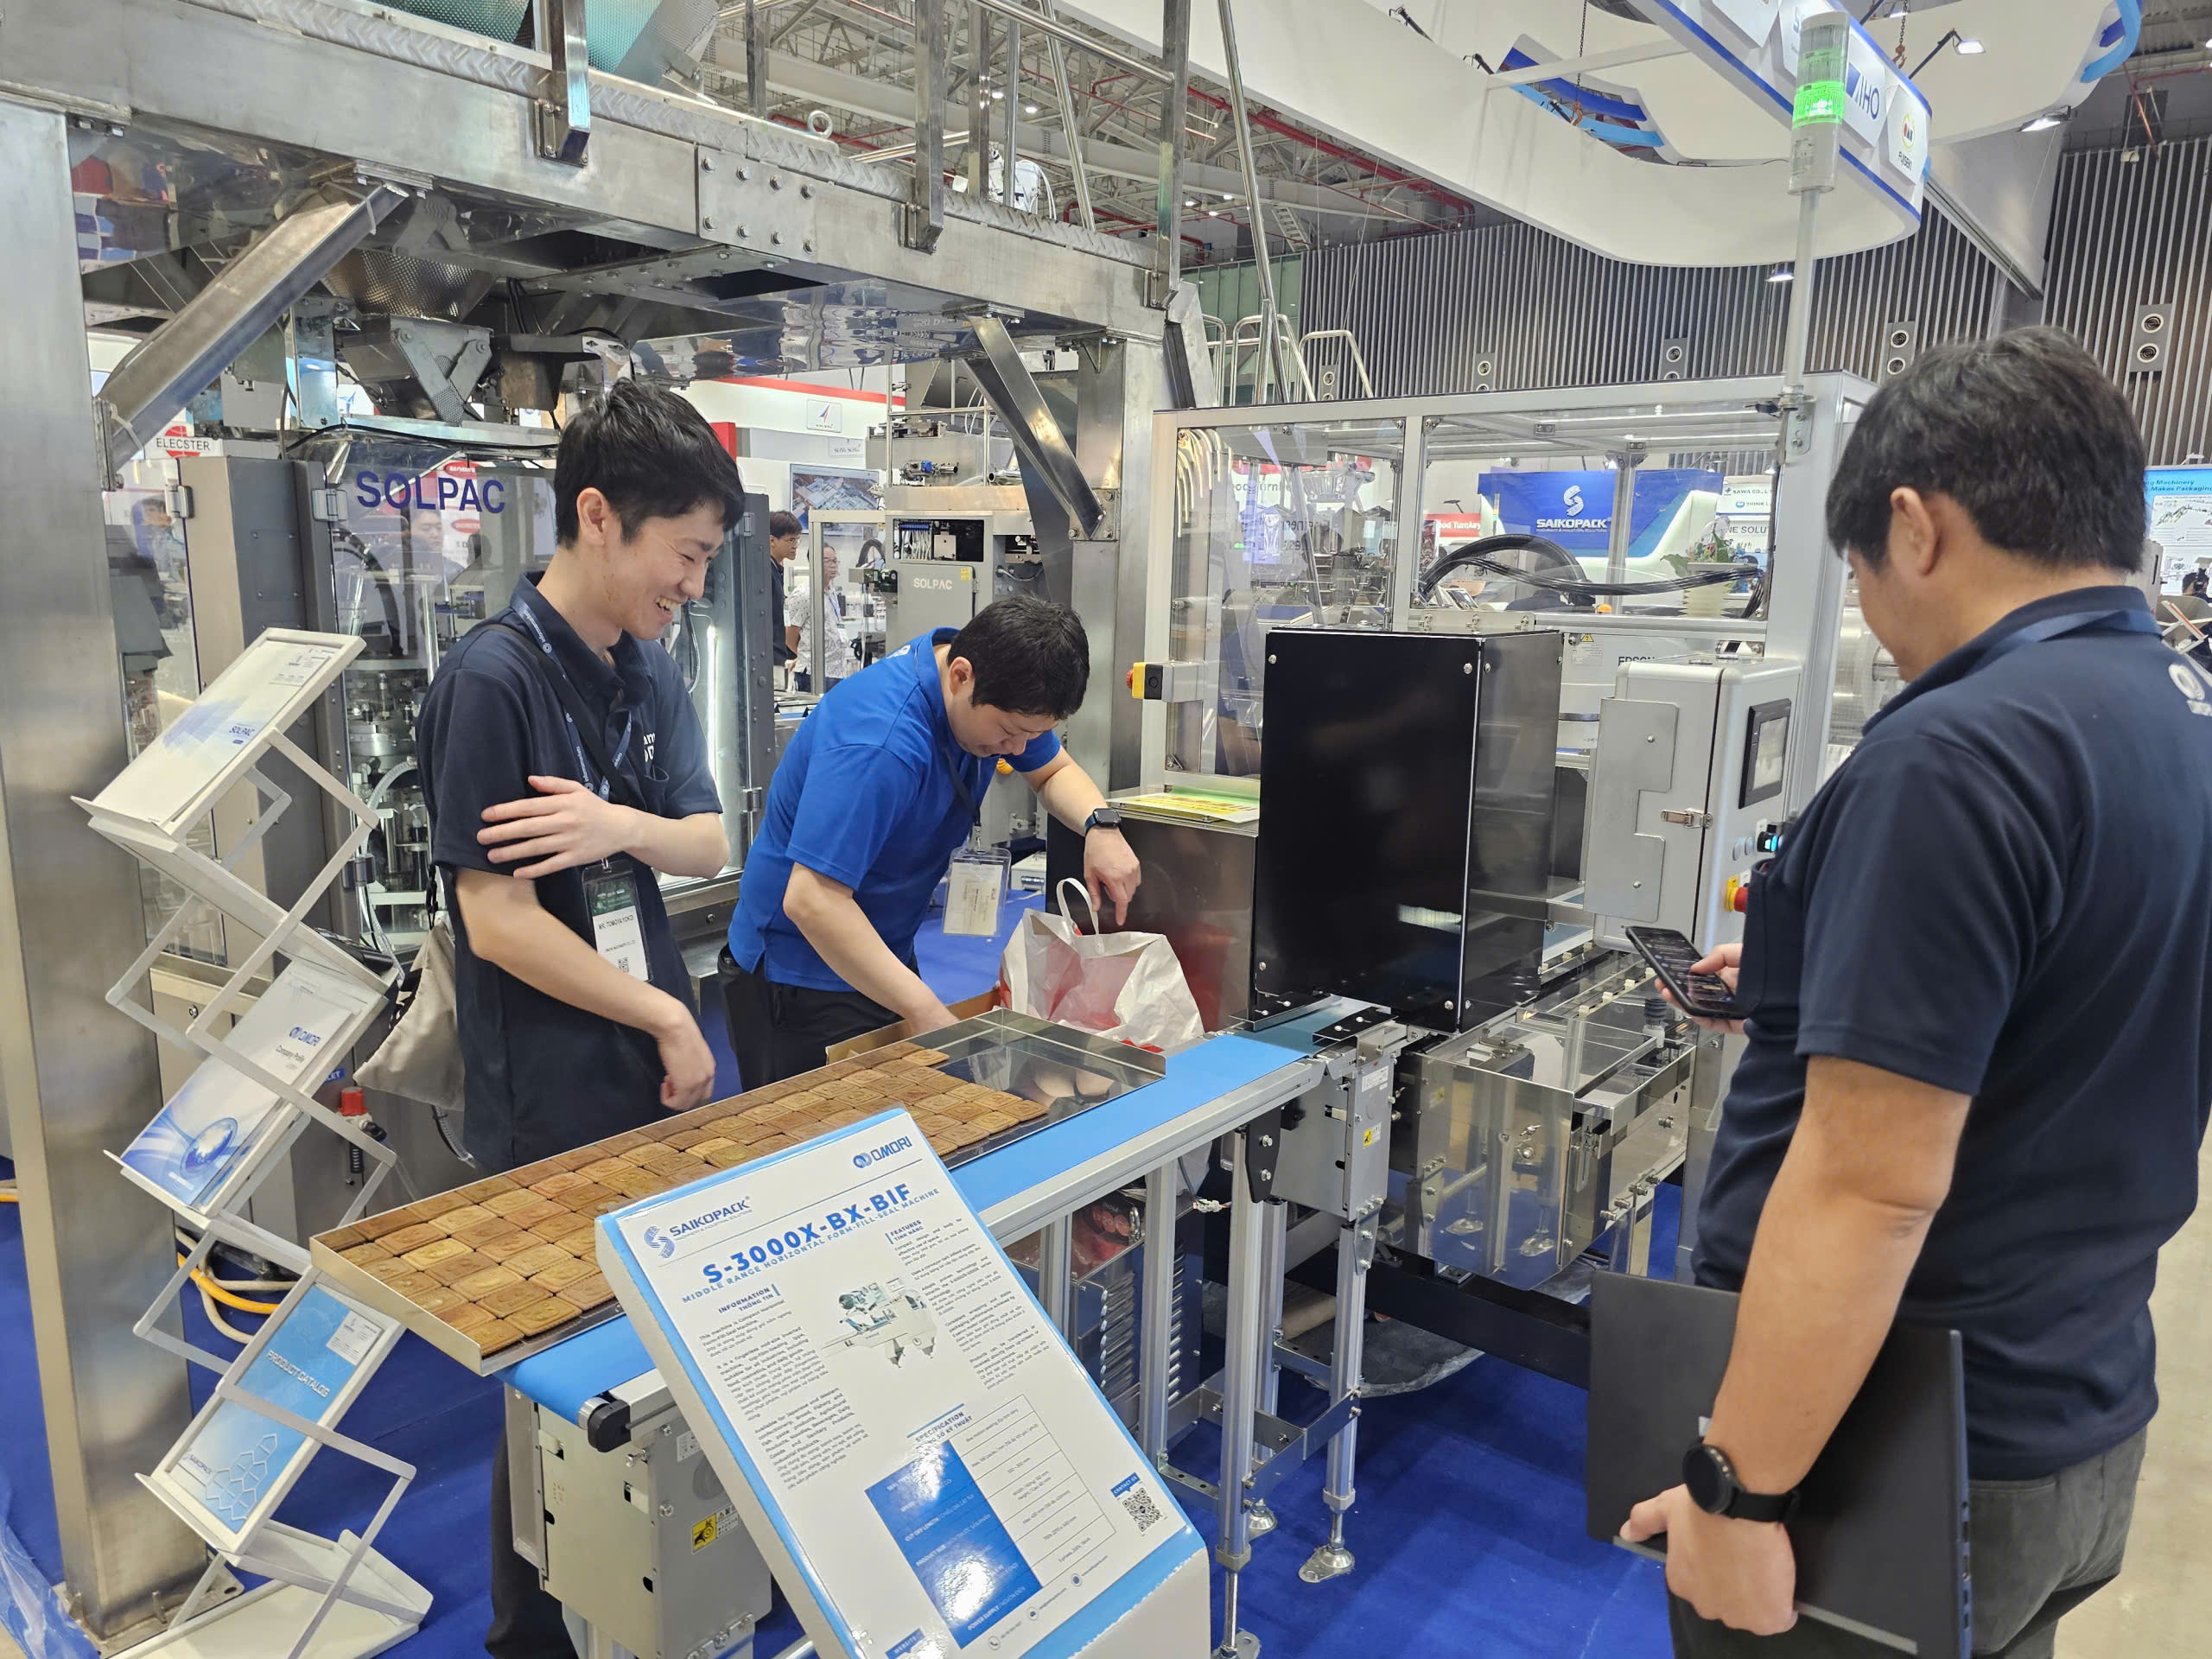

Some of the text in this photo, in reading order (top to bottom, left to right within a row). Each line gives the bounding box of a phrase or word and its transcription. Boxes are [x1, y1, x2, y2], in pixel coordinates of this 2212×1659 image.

[156, 438, 211, 451] ELECSTER
[357, 471, 505, 514] SOLPAC
[1536, 518, 1608, 529] SAIKOPACK
[913, 577, 953, 590] SOLPAC
[869, 1135, 912, 1161] OMORI
[668, 1199, 749, 1236] SAIKOPACK
[890, 1219, 921, 1236] FEATURES
[682, 1187, 940, 1303] MIDDLE RANGE HORIZONTAL FORM-FILL-SEAL MACHINE
[701, 1182, 913, 1284] S-3000X-BX-BIF
[718, 1287, 770, 1313] INFORMATION
[762, 1292, 774, 1300] TIN
[265, 1350, 302, 1376] PRODUCT
[915, 1411, 965, 1443] SPECIFICATION
[1113, 1480, 1132, 1495] CONTACT
[893, 1636, 917, 1655] WEBSITE
